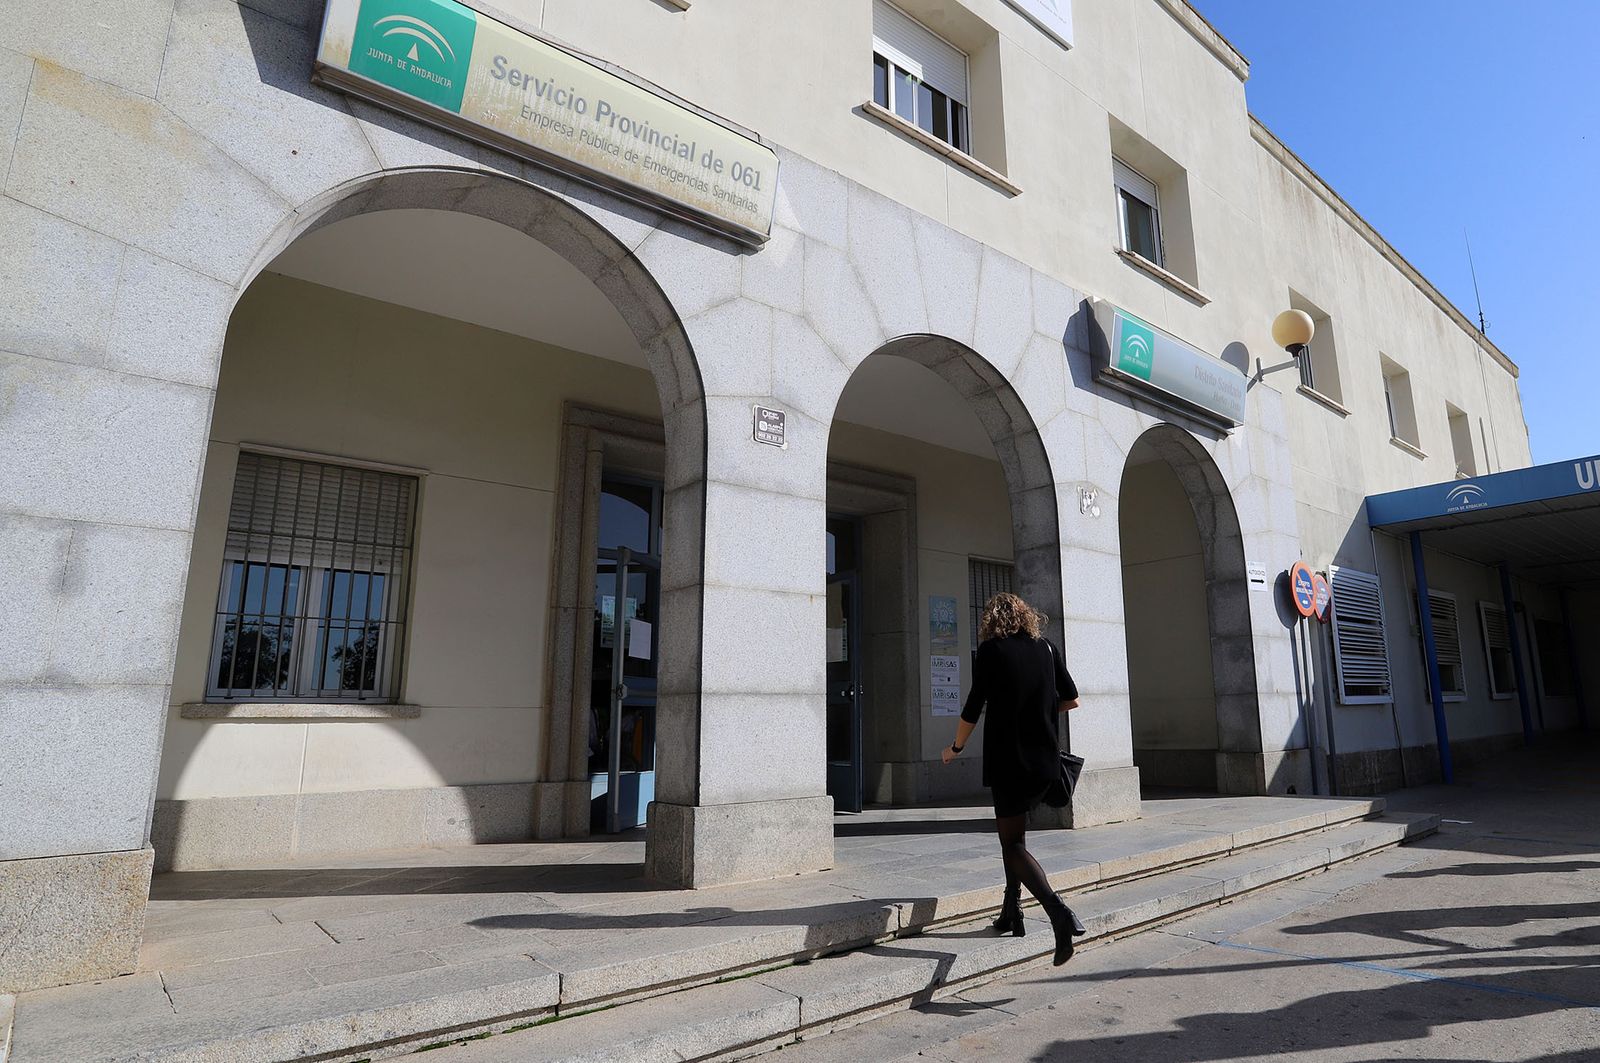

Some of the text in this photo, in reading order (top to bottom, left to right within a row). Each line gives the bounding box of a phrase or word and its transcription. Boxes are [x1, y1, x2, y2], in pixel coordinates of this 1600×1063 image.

[367, 47, 453, 89] JUNTA DE ANDALUCIA
[490, 54, 761, 192] Servicio Provincial de 061
[520, 104, 759, 214] Empresa Pública de Emergencias Sanitarias
